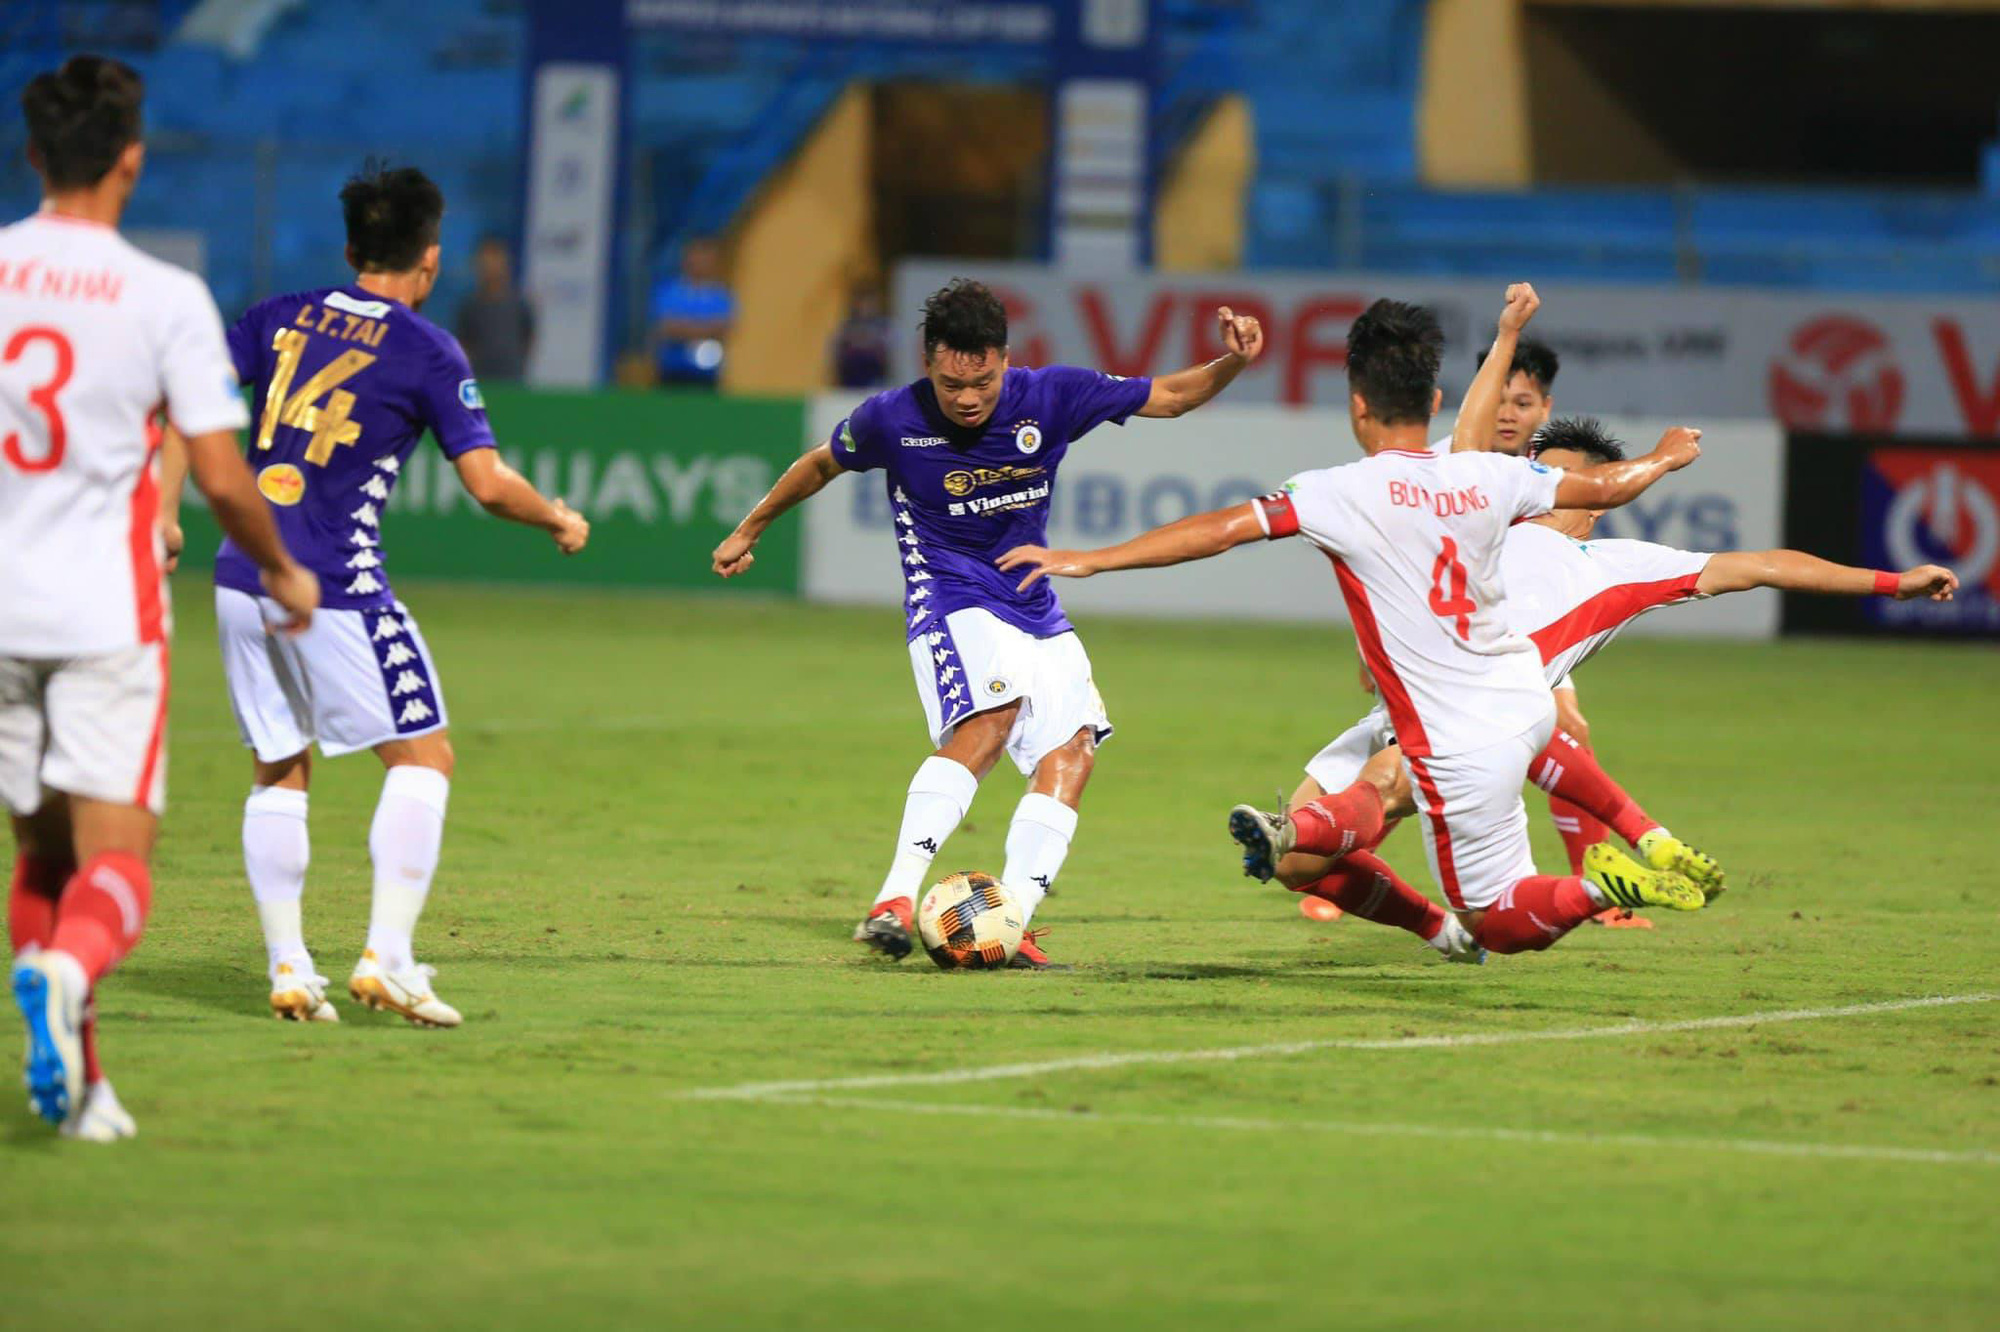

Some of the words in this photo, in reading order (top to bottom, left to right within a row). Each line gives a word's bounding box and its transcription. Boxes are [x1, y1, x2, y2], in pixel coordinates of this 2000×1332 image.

[2, 323, 75, 474] 3
[257, 327, 377, 467] 14
[1072, 288, 1370, 411] VPF
[388, 448, 774, 526] IWAYS
[848, 473, 1277, 538] BBO
[1428, 535, 1478, 641] 4
